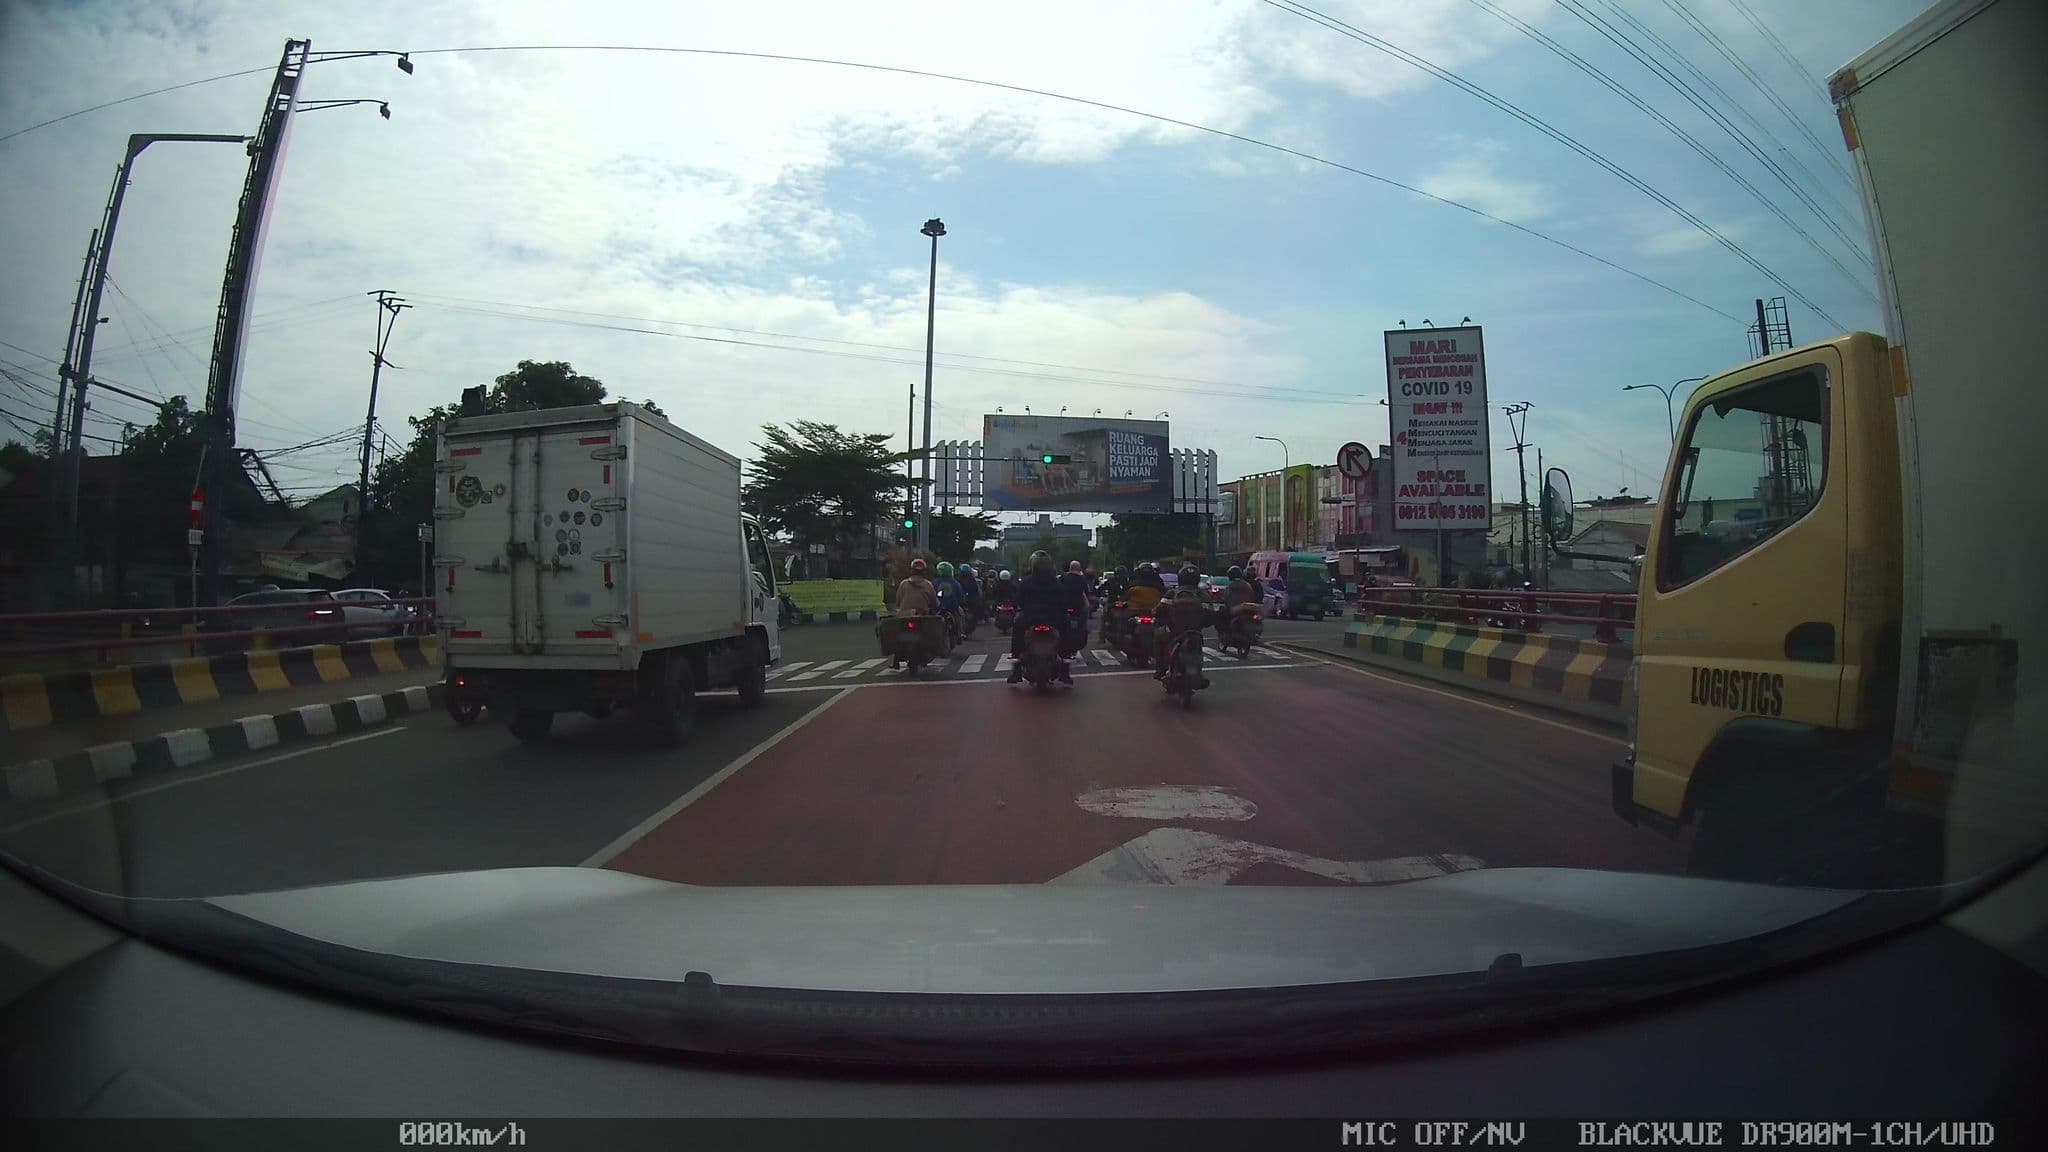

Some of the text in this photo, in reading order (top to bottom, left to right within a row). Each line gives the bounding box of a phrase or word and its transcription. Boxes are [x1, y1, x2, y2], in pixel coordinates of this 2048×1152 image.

[1409, 339, 1457, 354] MARI
[1401, 380, 1473, 397] COVID 19
[1109, 431, 1145, 445] RUANG
[1396, 431, 1407, 445] 4
[1408, 429, 1445, 437] MENCUCI
[1109, 443, 1159, 457] KELUARGA
[1109, 455, 1158, 467] PASTI JADI
[1109, 466, 1151, 477] NYAMAN
[1416, 470, 1466, 483] SPACE
[1398, 484, 1486, 497] AVAILABLE
[1690, 667, 1784, 716] LOGISTICS
